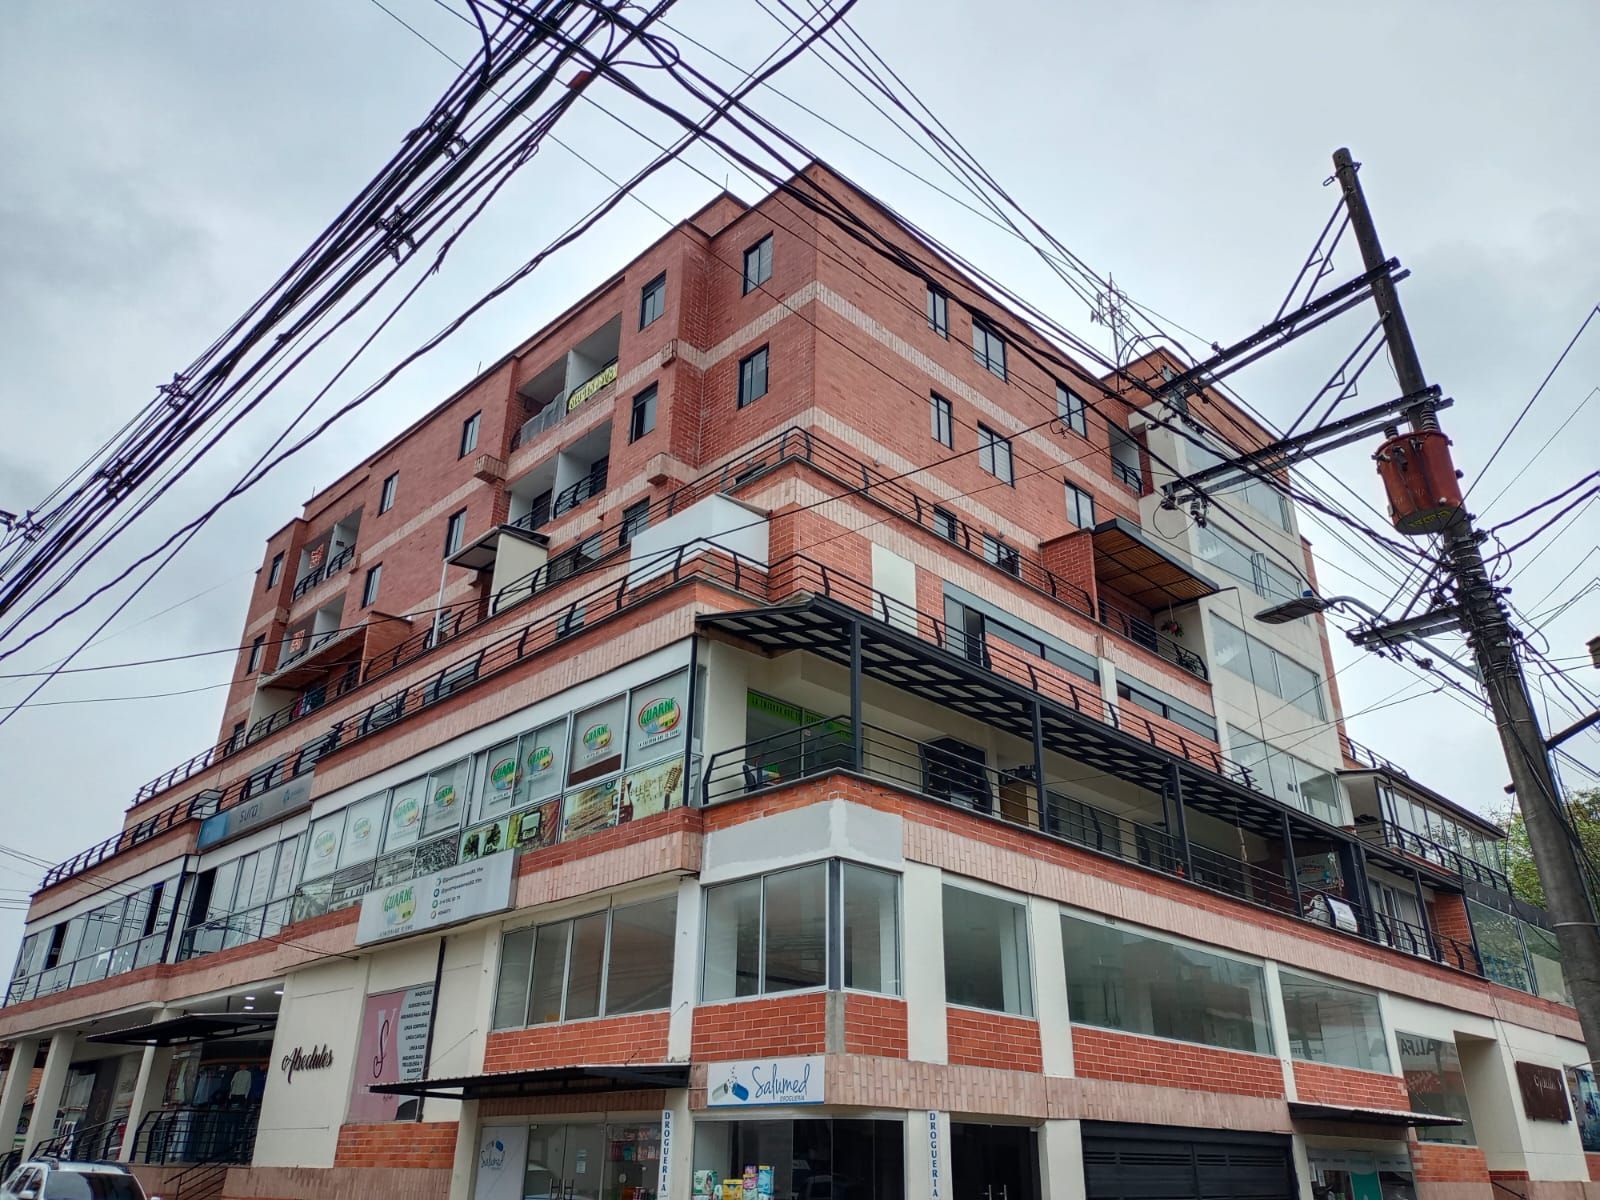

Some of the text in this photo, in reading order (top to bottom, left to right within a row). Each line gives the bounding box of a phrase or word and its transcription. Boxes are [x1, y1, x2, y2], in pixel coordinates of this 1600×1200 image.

[641, 698, 676, 724] GUARNE
[384, 886, 414, 912] GUARNE
[752, 1063, 811, 1099] Salumed
[661, 1112, 671, 1192] DROGUERIA
[929, 1112, 939, 1197] DROGUERIA
